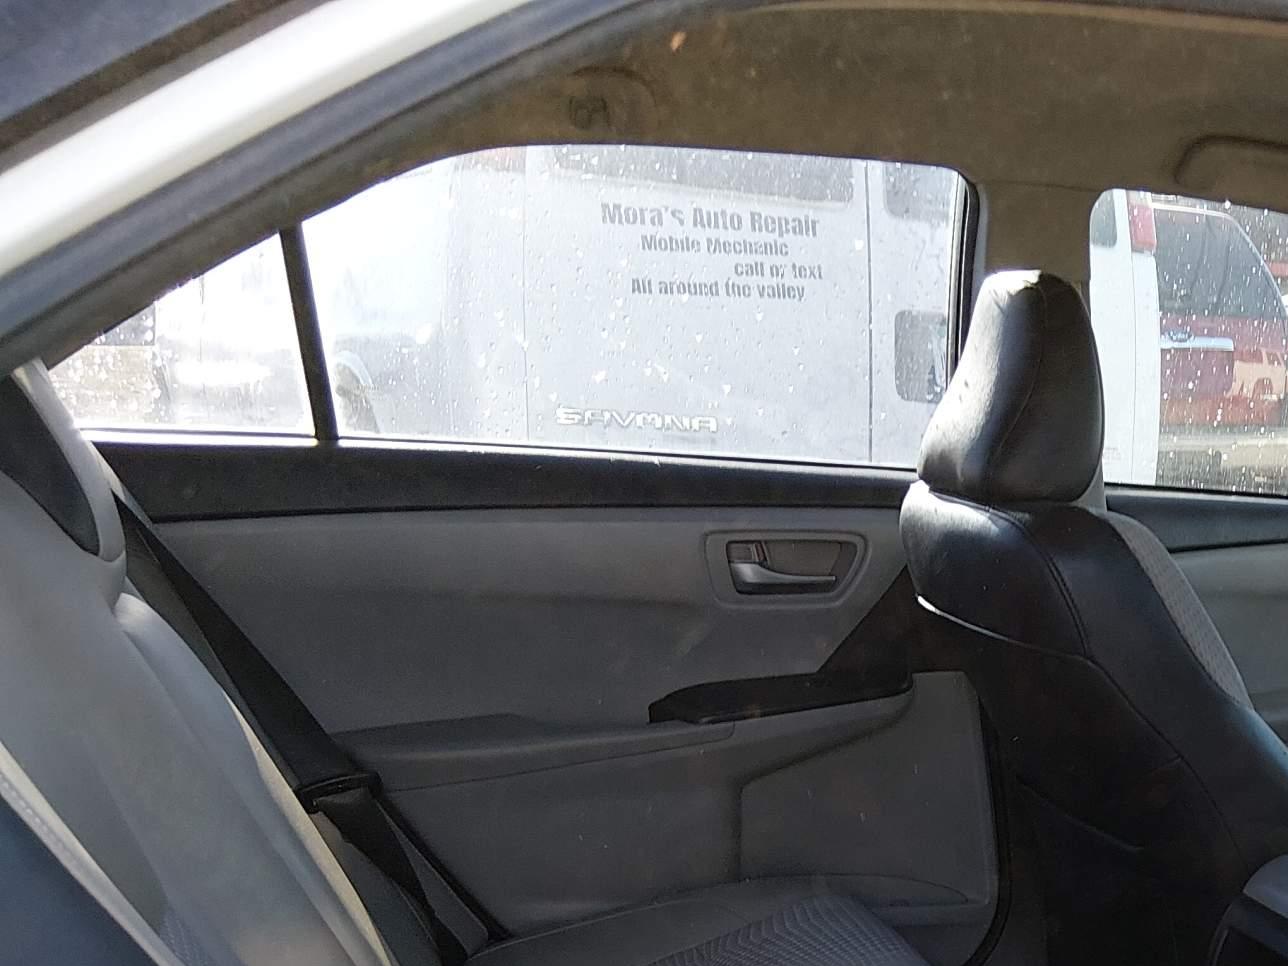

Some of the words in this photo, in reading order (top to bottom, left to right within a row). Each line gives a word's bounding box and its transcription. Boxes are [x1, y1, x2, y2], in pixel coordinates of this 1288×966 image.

[601, 202, 685, 227] Mora's
[692, 207, 743, 231] Auto
[749, 211, 819, 238] Repair
[641, 234, 701, 253] Mobile
[706, 237, 789, 257] Mechanic
[734, 261, 765, 278] call
[769, 264, 786, 279] or
[791, 262, 823, 280] text
[631, 278, 653, 295] All
[658, 280, 720, 297] around
[725, 279, 752, 298] the
[756, 282, 805, 301] valley
[555, 406, 718, 433] SAVANA
